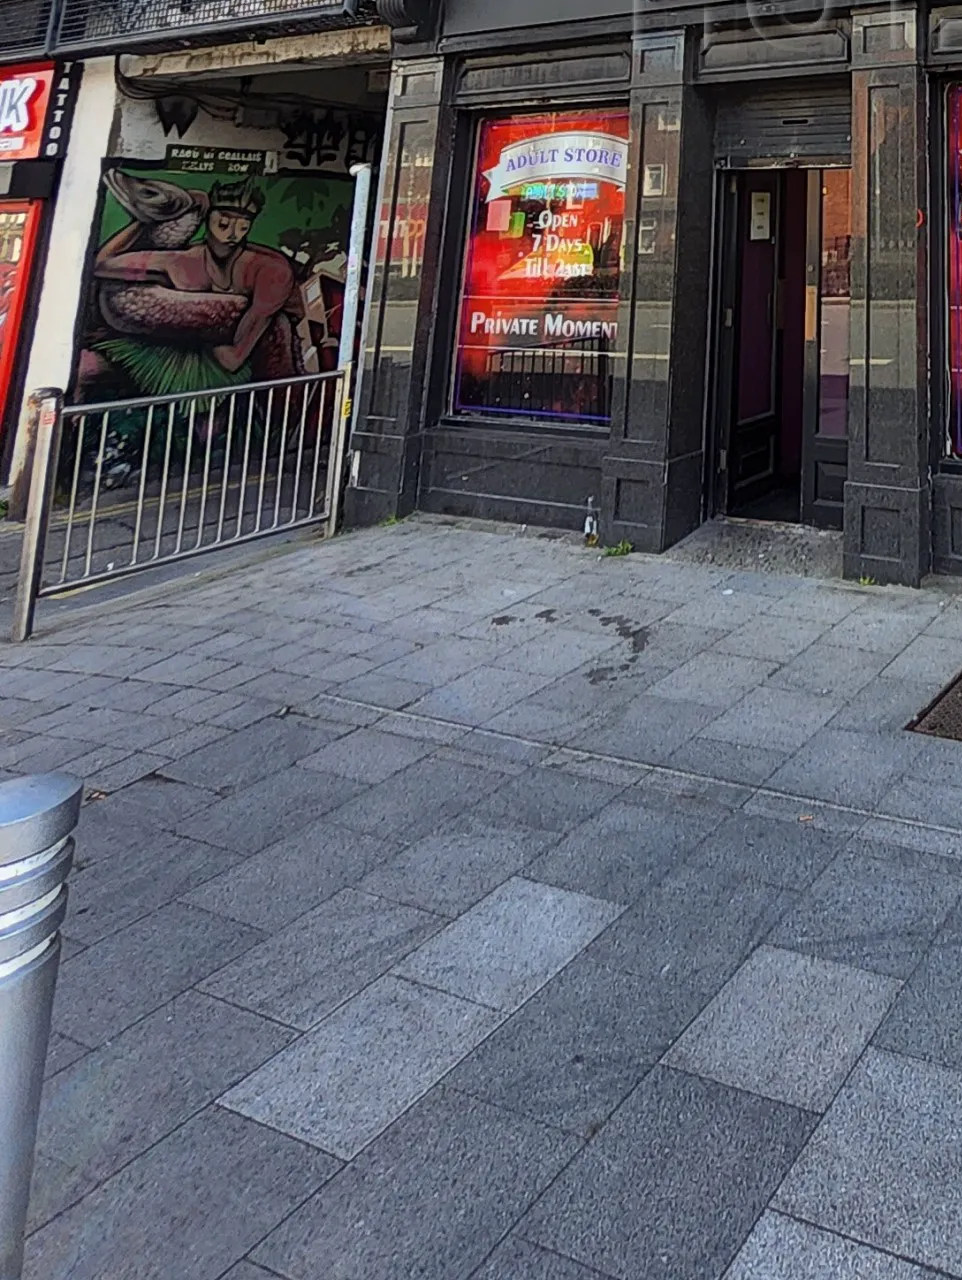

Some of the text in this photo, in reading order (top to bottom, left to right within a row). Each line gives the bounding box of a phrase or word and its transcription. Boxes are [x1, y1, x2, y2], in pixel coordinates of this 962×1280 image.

[45, 62, 74, 156] TATTOO
[506, 147, 622, 172] ADULT STORE
[532, 234, 542, 252] 7
